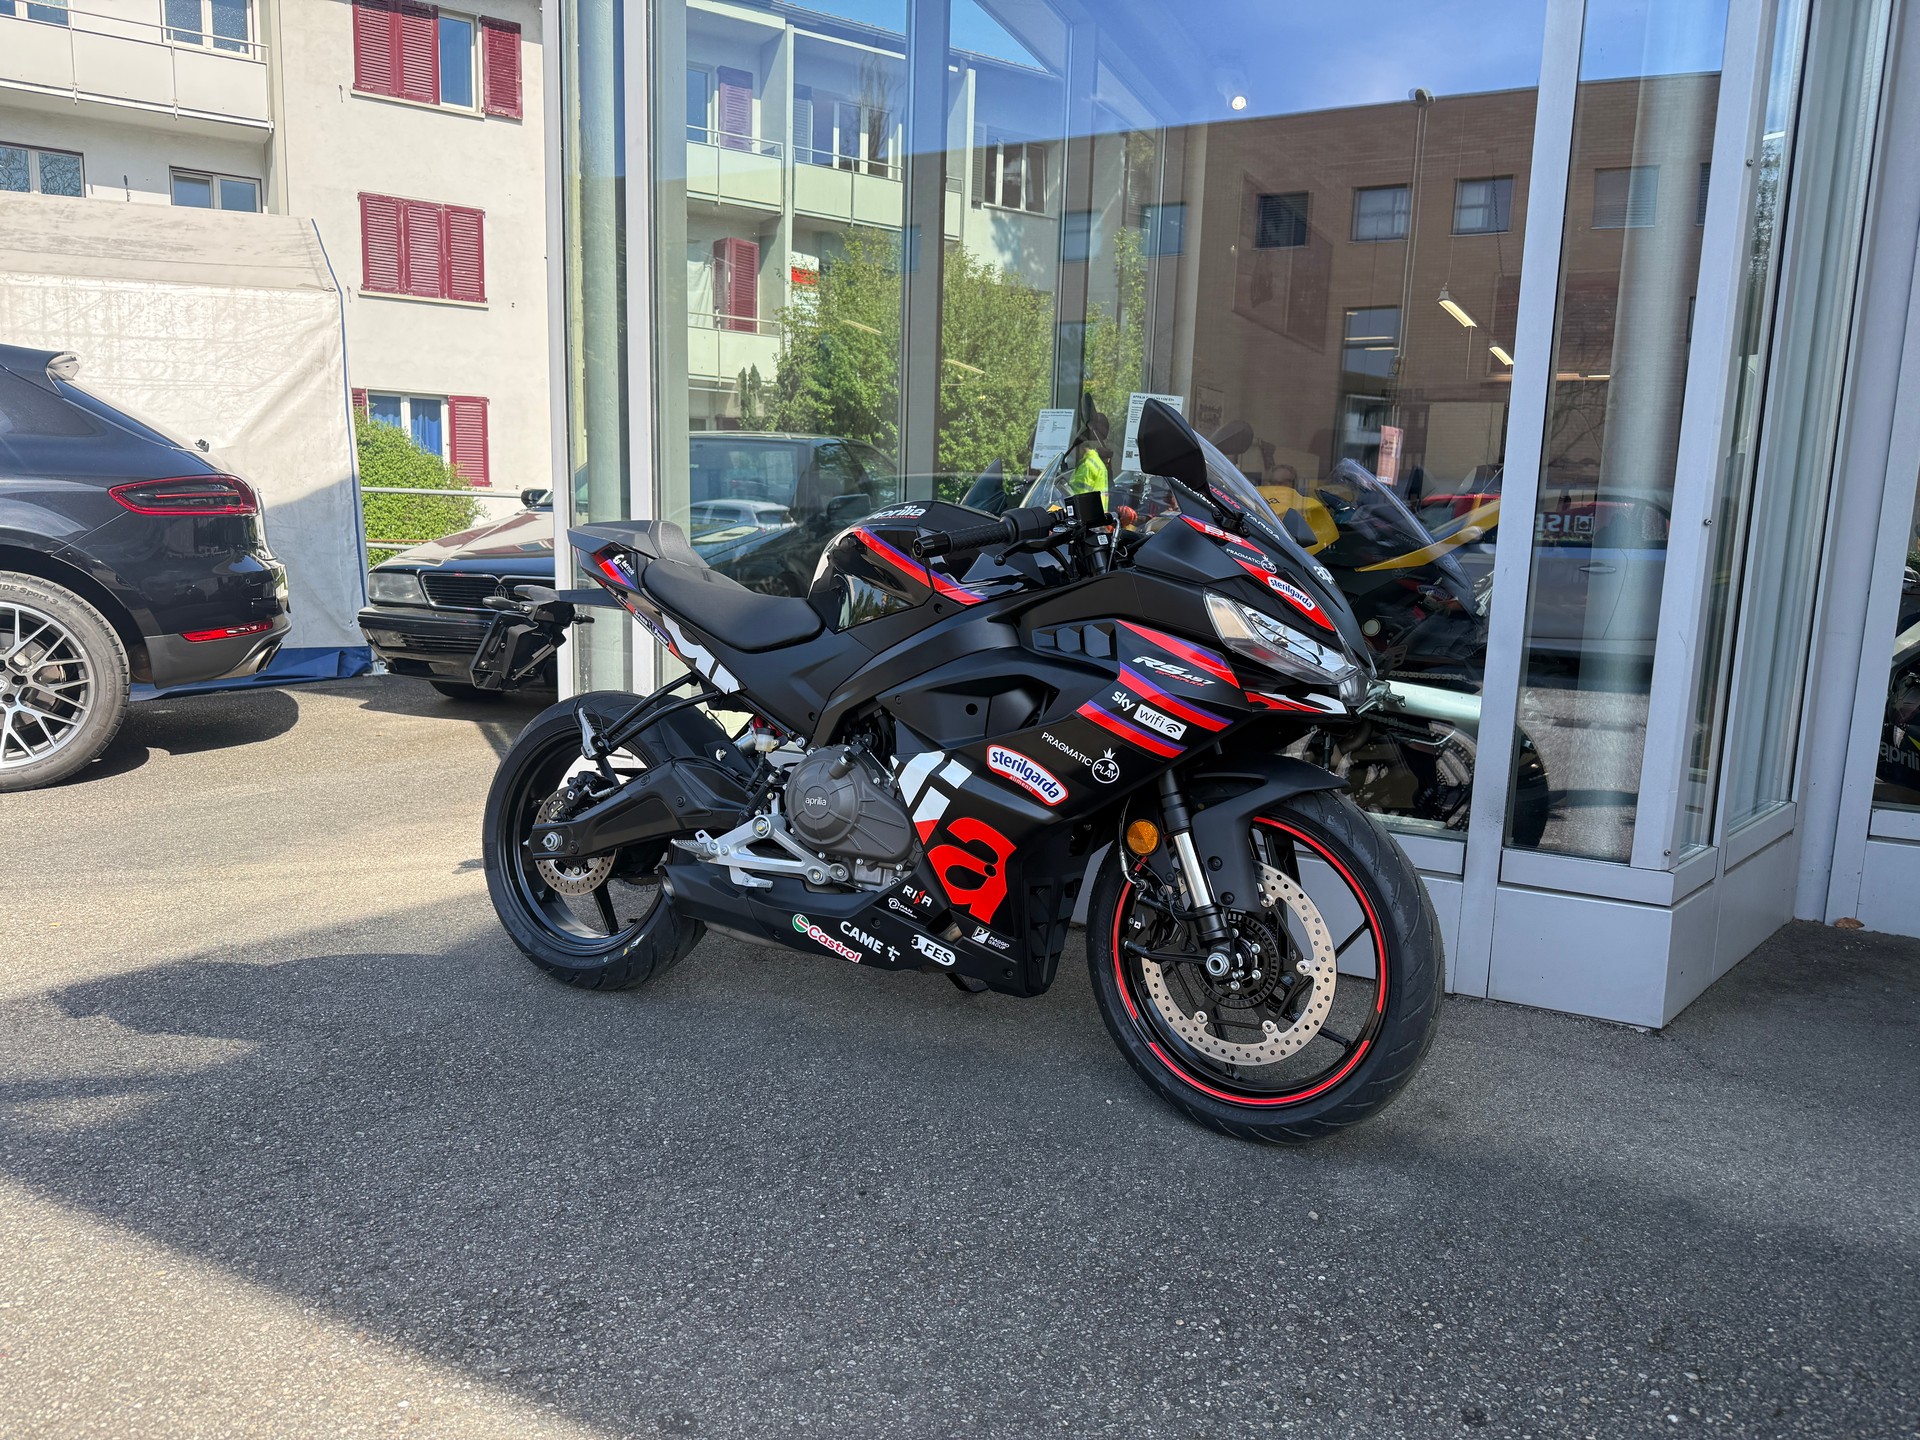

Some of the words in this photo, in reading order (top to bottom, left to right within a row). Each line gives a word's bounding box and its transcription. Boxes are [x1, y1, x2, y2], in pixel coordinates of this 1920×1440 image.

[866, 505, 927, 520] aprilia
[1270, 578, 1313, 608] sterilgarda
[1111, 691, 1136, 712] sky
[1139, 709, 1166, 728] wifi
[1041, 731, 1093, 767] PRAGMATIC
[1094, 763, 1118, 780] PLAY
[991, 750, 1060, 799] sterilgarda
[1008, 775, 1033, 793] alimenti
[805, 796, 827, 807] aprilia
[807, 924, 863, 964] Castrol
[840, 920, 884, 954] CAME
[924, 942, 952, 964] FES
